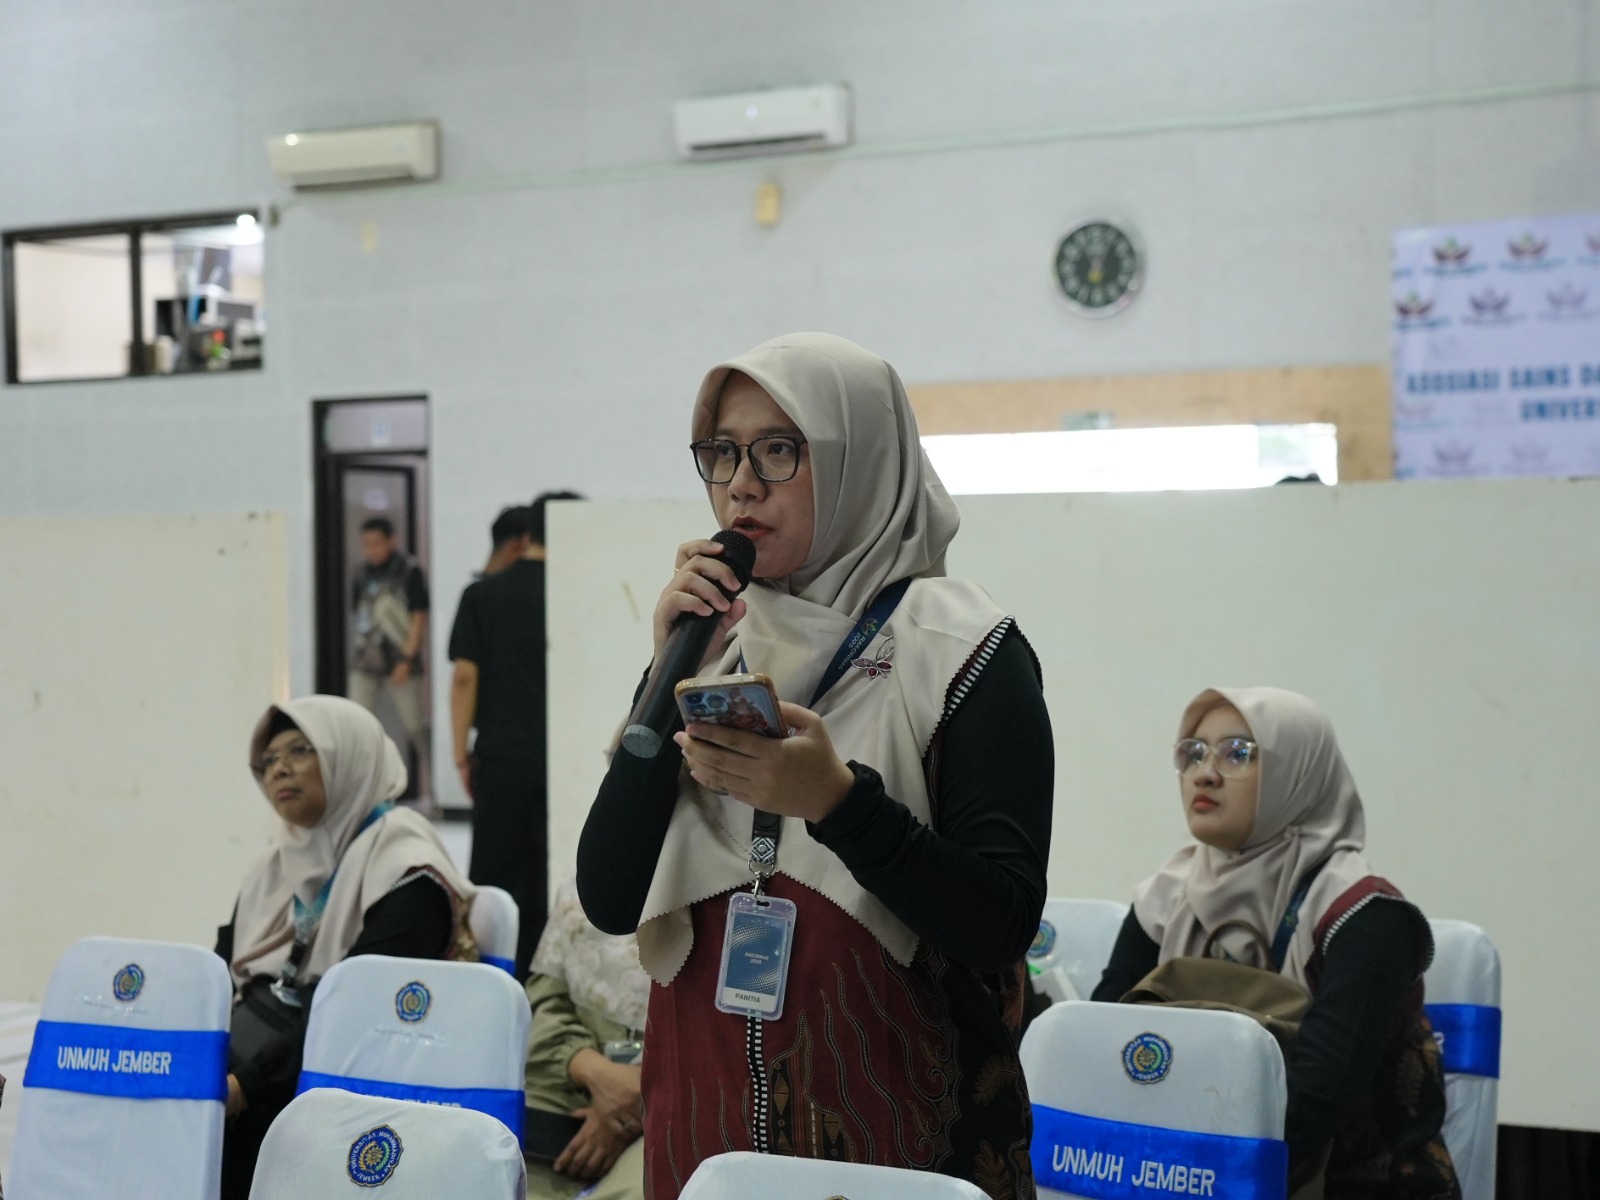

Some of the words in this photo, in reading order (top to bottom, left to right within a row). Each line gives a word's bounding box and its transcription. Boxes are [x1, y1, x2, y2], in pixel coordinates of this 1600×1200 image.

[1520, 398, 1600, 421] UNIVER
[848, 631, 862, 649] 2025
[735, 992, 761, 1003] PANITIA
[57, 1045, 110, 1073] UNMUH
[112, 1049, 172, 1075] JEMBER
[1052, 1144, 1124, 1184] UNMUH
[1131, 1160, 1216, 1197] JEMBER
